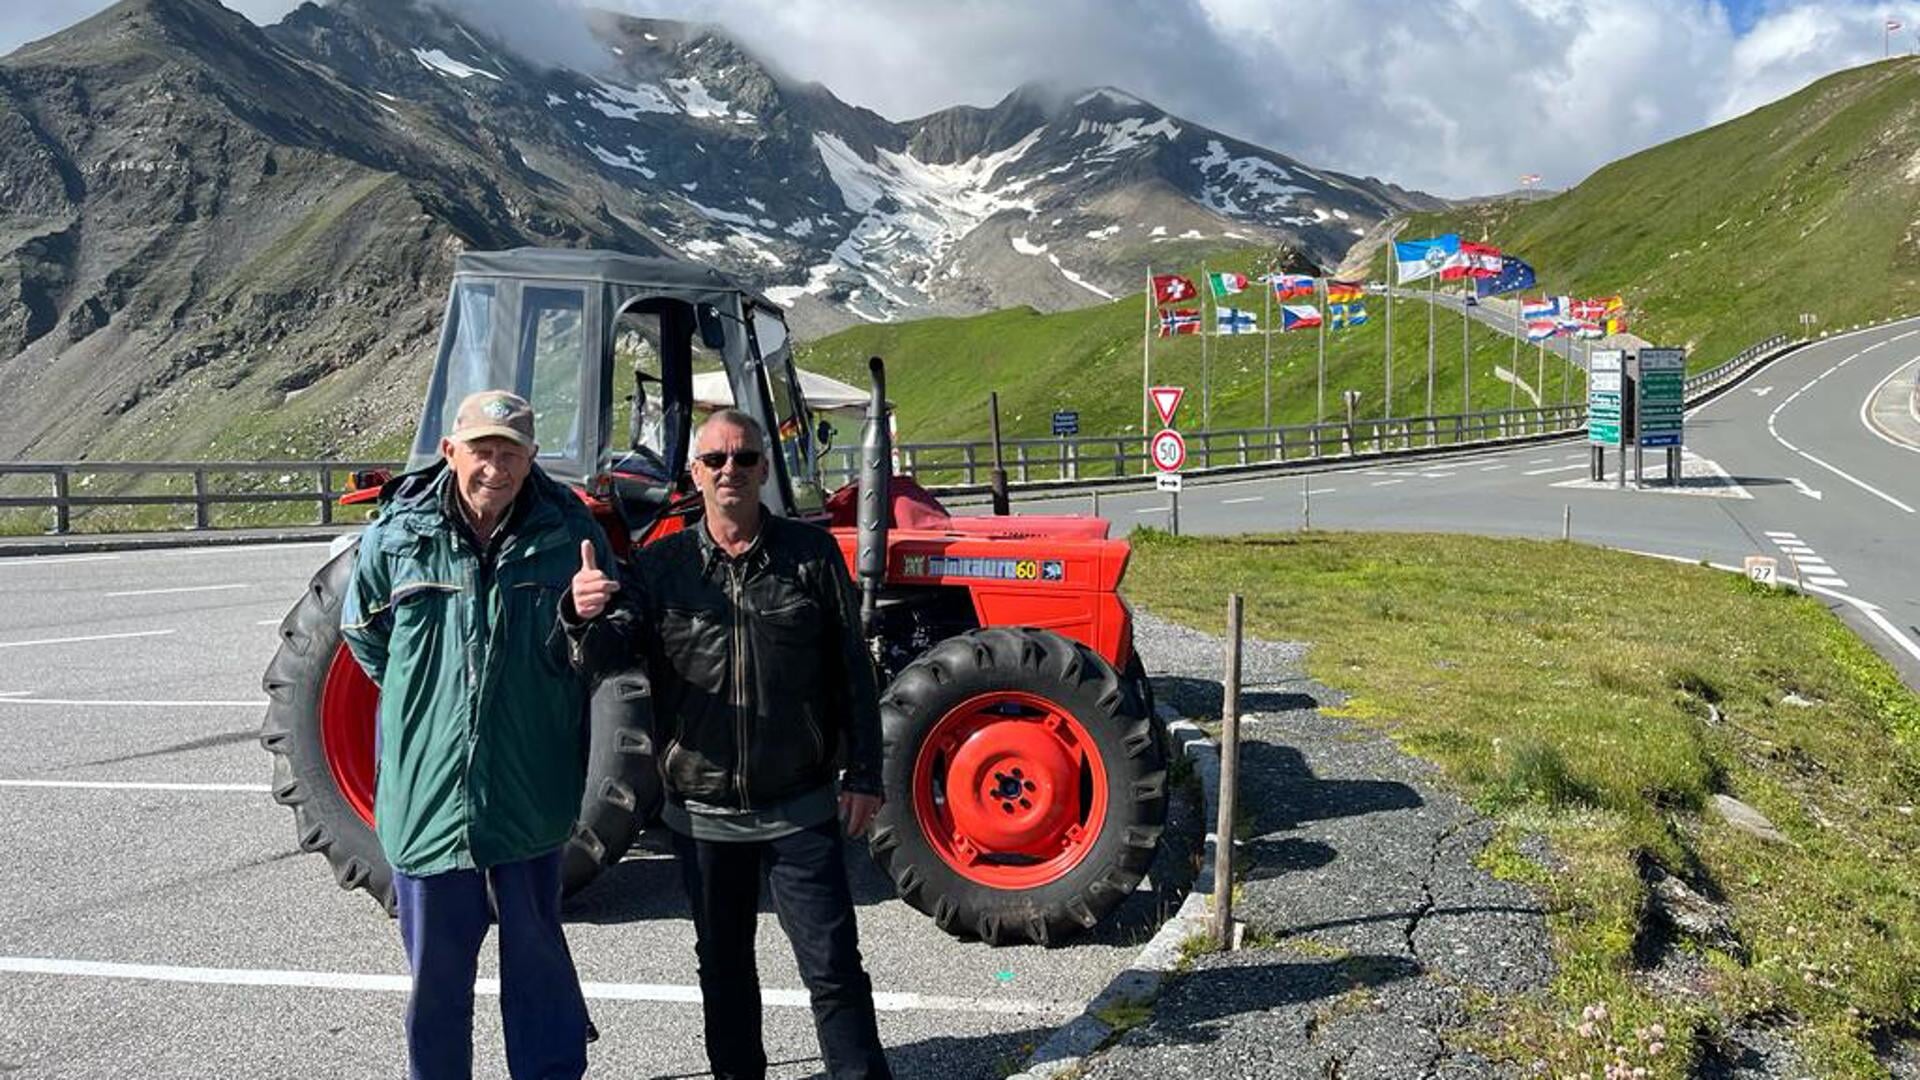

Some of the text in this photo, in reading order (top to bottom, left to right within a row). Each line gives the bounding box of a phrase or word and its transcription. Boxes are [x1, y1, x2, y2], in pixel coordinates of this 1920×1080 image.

[1160, 442, 1176, 461] 50
[1016, 560, 1036, 579] 60
[1754, 567, 1771, 580] 27
